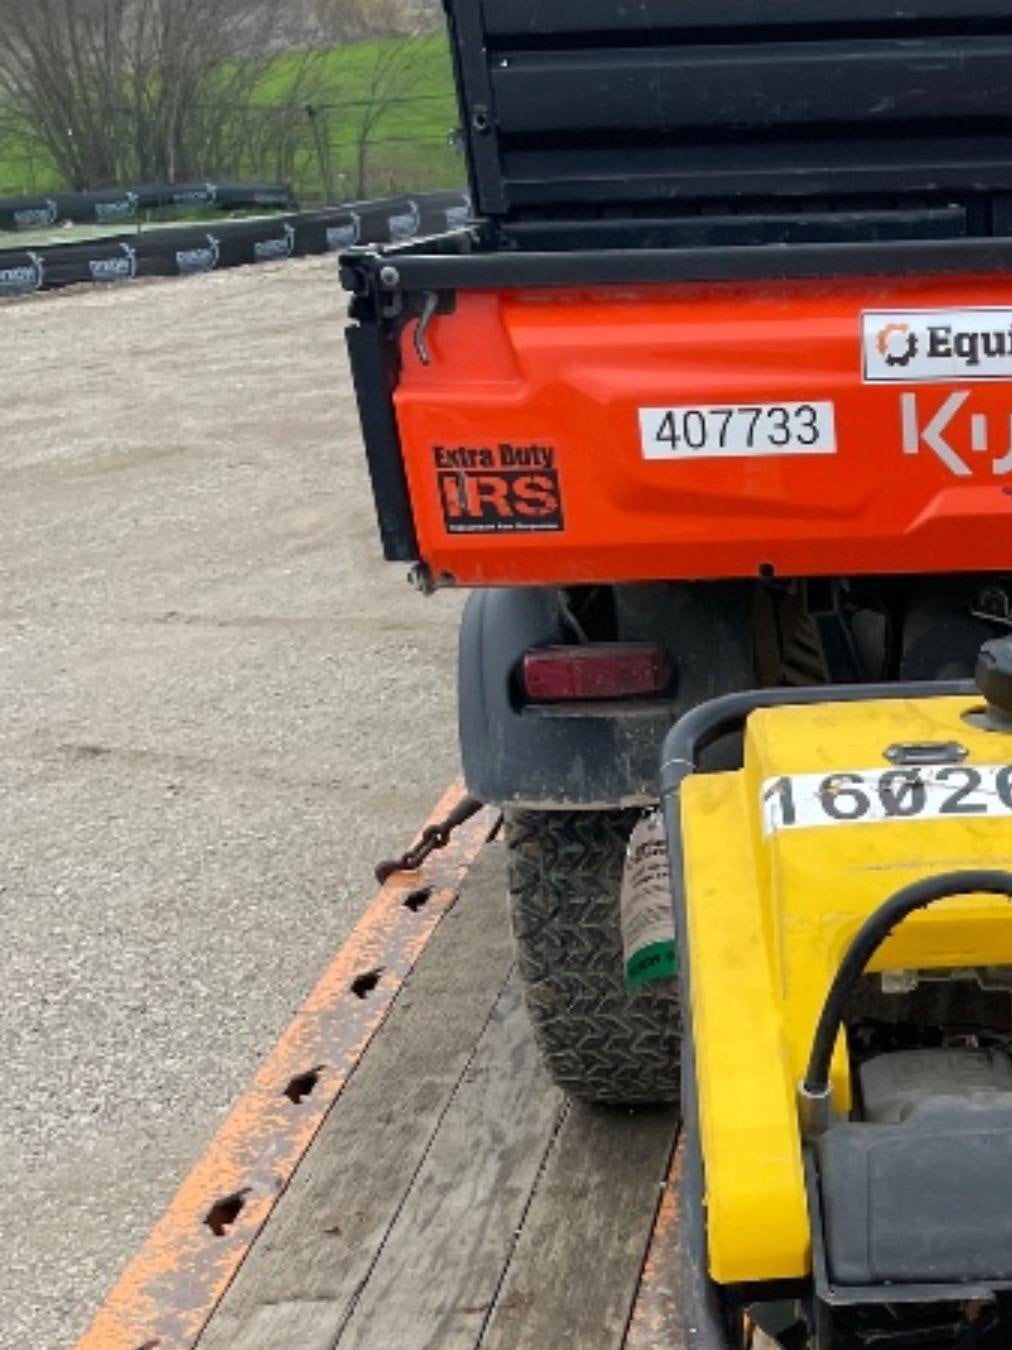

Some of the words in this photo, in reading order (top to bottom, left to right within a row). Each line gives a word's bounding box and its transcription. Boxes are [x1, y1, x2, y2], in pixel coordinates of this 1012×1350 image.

[654, 404, 819, 450] 407733
[432, 446, 494, 468] Extra
[499, 443, 553, 468] Duty
[443, 475, 558, 518] IRS
